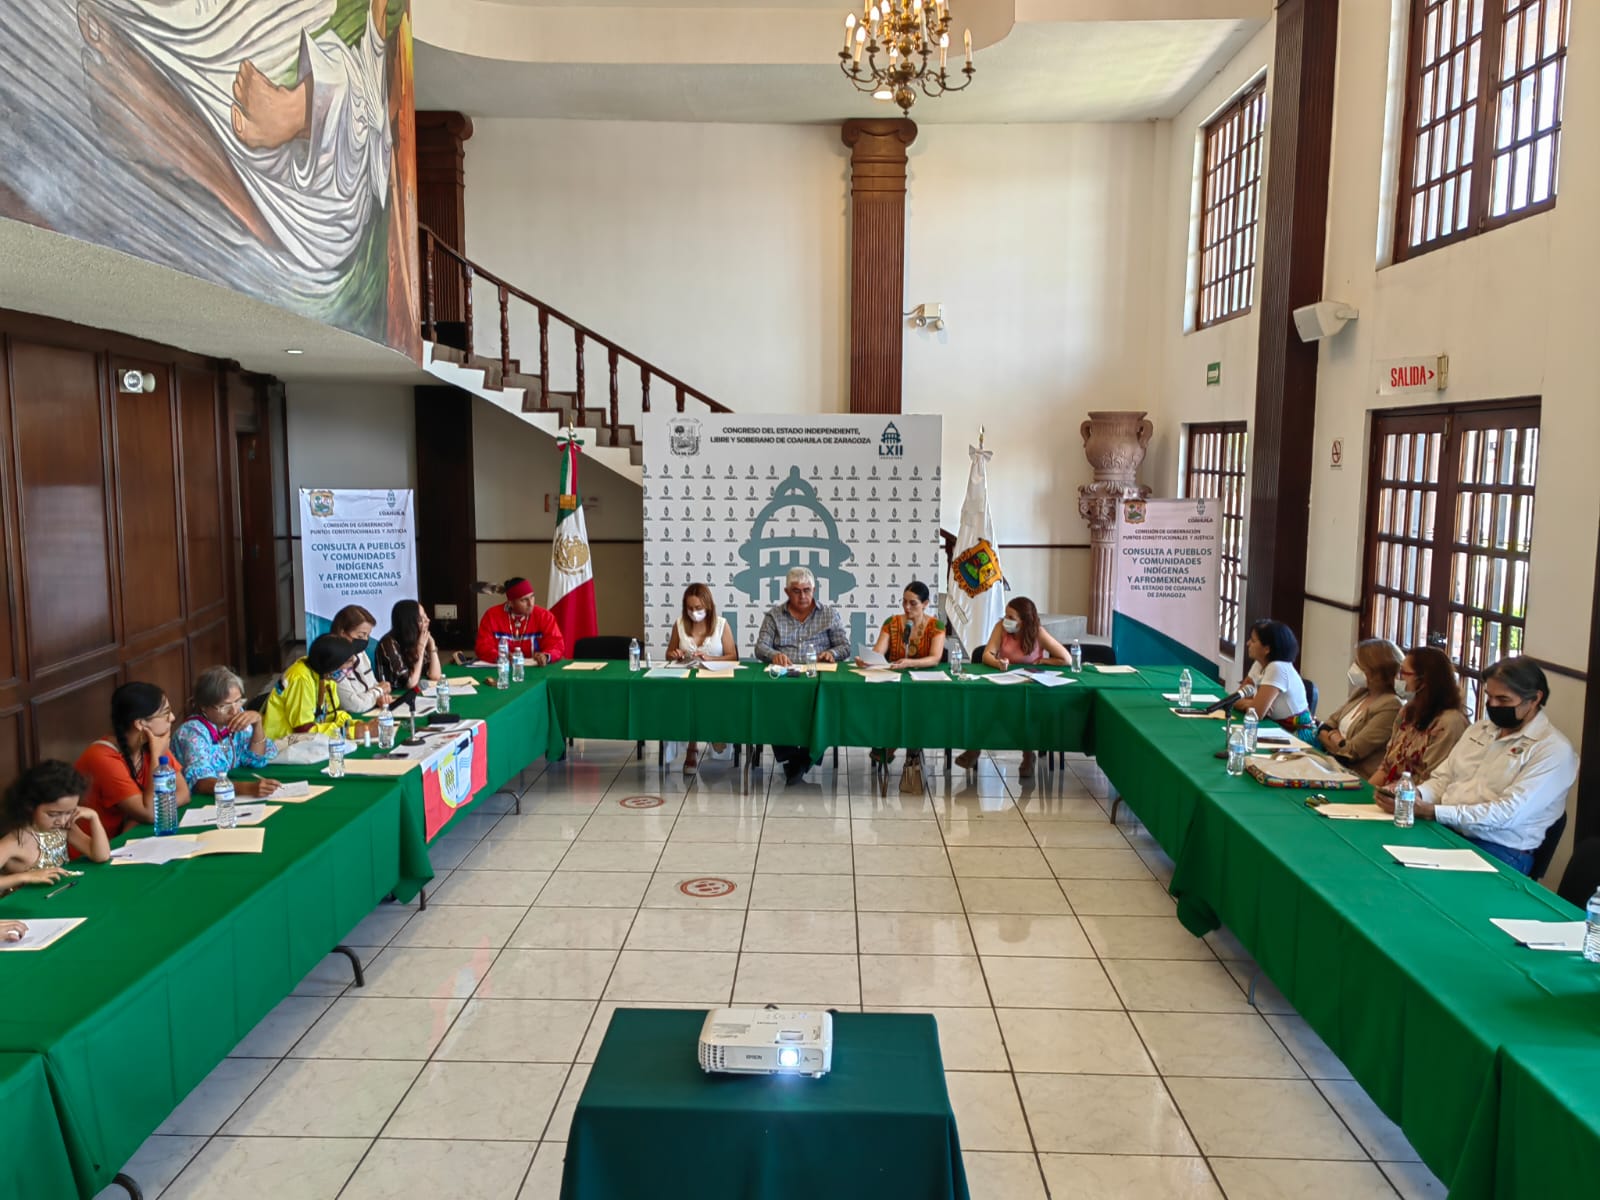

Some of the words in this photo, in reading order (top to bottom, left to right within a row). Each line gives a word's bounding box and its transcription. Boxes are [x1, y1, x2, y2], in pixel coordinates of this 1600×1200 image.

[1391, 366, 1426, 387] SALIDA
[804, 427, 861, 435] INDEPENDIENTE,
[710, 436, 730, 444] LIBRE
[736, 436, 775, 444] SOBERANO
[776, 436, 786, 444] DE
[879, 445, 903, 456] LXII
[311, 543, 357, 551] CONSULTA
[367, 542, 406, 550] PUEBLOS
[330, 552, 396, 560] COMUNIDADES
[1174, 548, 1212, 556] PUEBLOS
[336, 561, 384, 571] INDÍGENAS
[1144, 566, 1189, 574] INDÍGENAS
[327, 572, 401, 581] AFROMEXICANAS
[1135, 576, 1206, 584] AFROMEXICANAS
